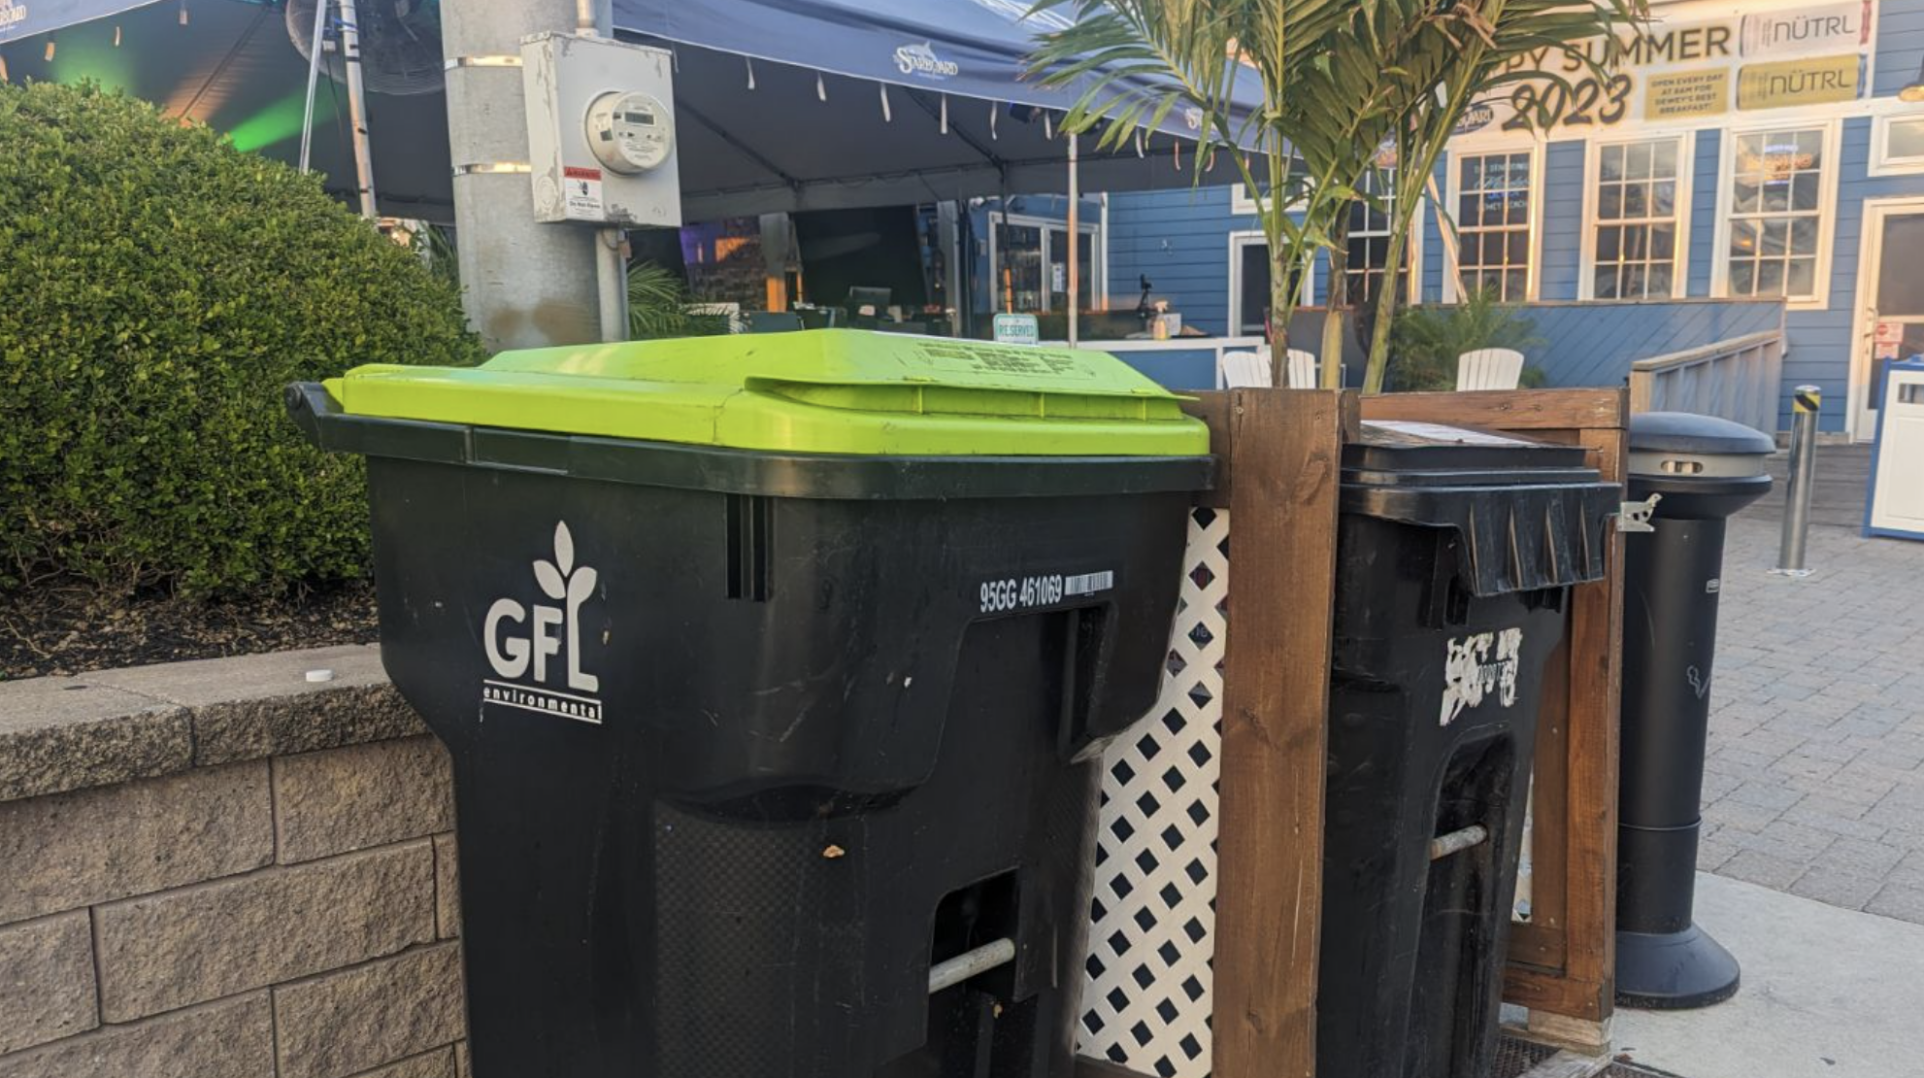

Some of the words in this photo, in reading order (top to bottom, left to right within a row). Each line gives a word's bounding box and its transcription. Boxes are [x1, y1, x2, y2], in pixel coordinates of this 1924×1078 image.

[1562, 26, 1731, 72] SUMMER
[1677, 76, 1704, 84] EVERY
[1706, 73, 1724, 82] DAY
[1501, 74, 1632, 131] 2023
[999, 324, 1035, 337] RESERVED
[980, 579, 1017, 613] 95GG
[1019, 574, 1063, 607] 461069
[484, 570, 599, 693] GFL
[483, 686, 602, 721] environmental
